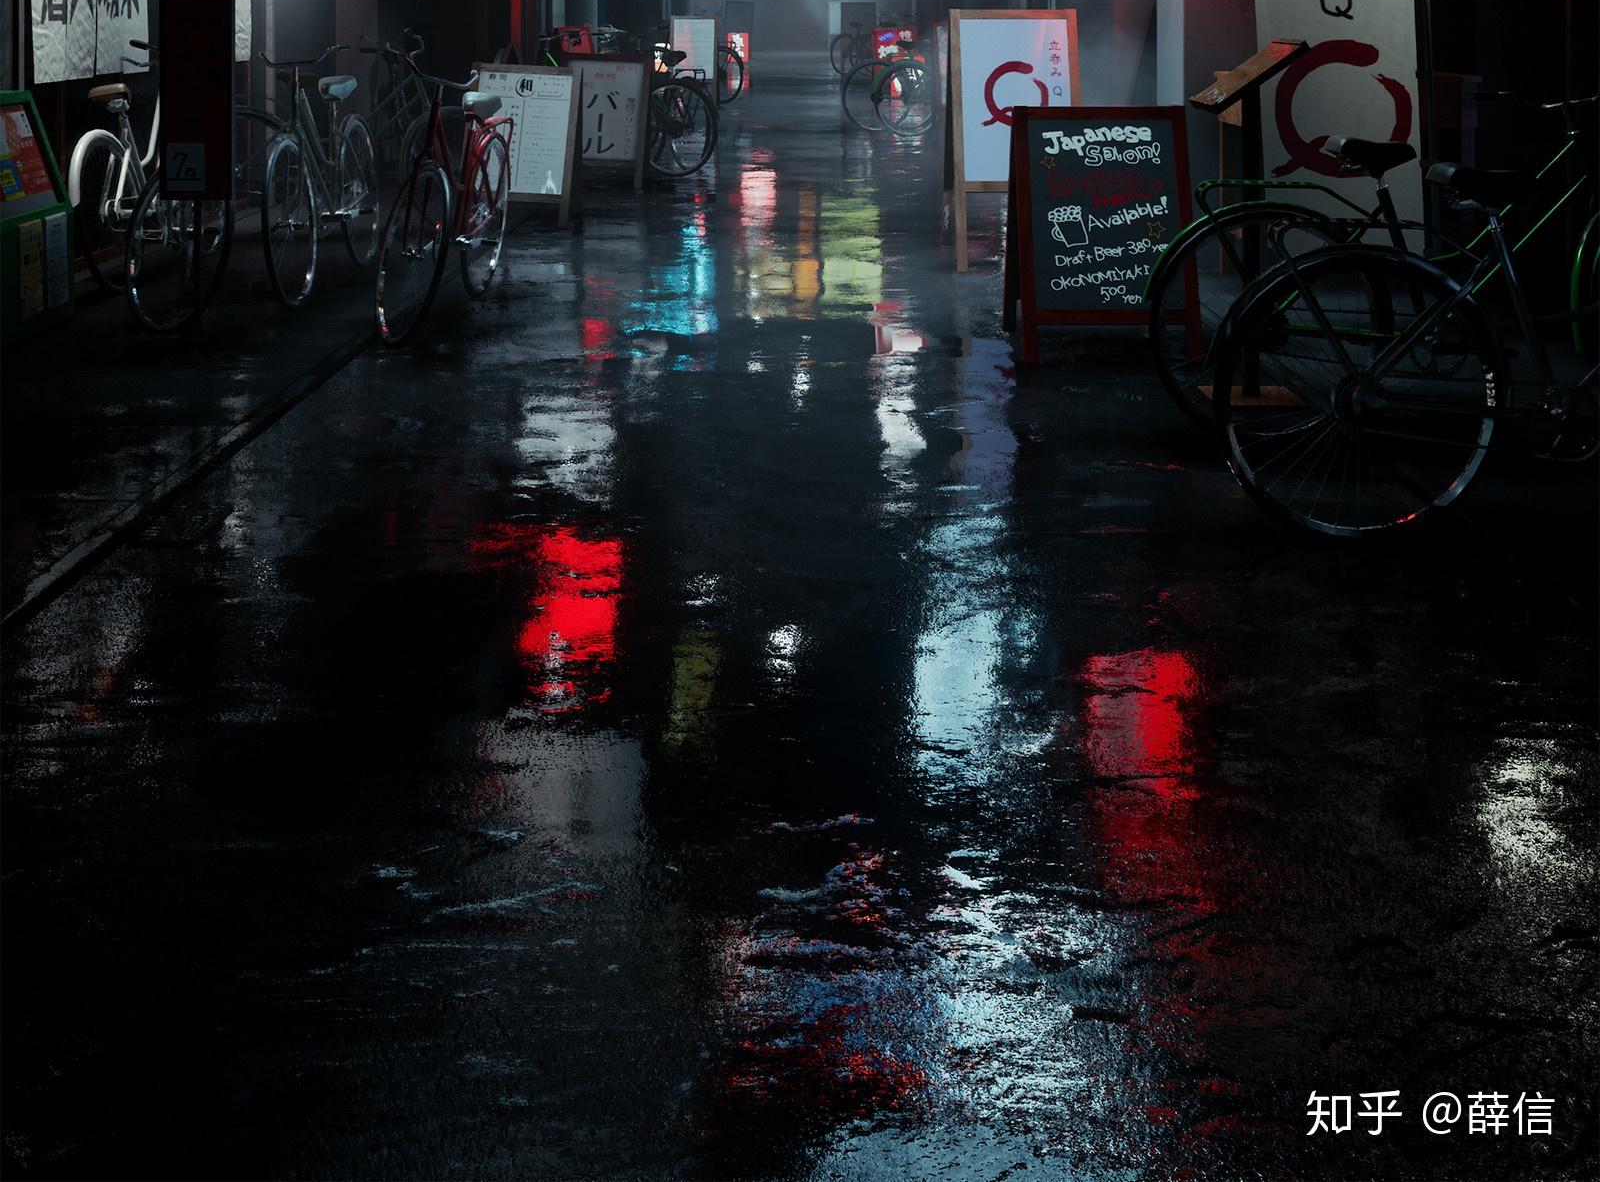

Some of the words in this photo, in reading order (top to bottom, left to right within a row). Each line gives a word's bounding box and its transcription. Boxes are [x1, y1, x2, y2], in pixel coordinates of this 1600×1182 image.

[1042, 125, 1152, 156] Japanese
[1087, 195, 1170, 232] Available!
[1055, 251, 1093, 267] Draft
[1095, 245, 1124, 262] Beer
[1127, 237, 1151, 255] 380
[1051, 264, 1150, 291] OKONOMIYAKI
[1101, 284, 1126, 301] 500
[1123, 293, 1142, 305] yen
